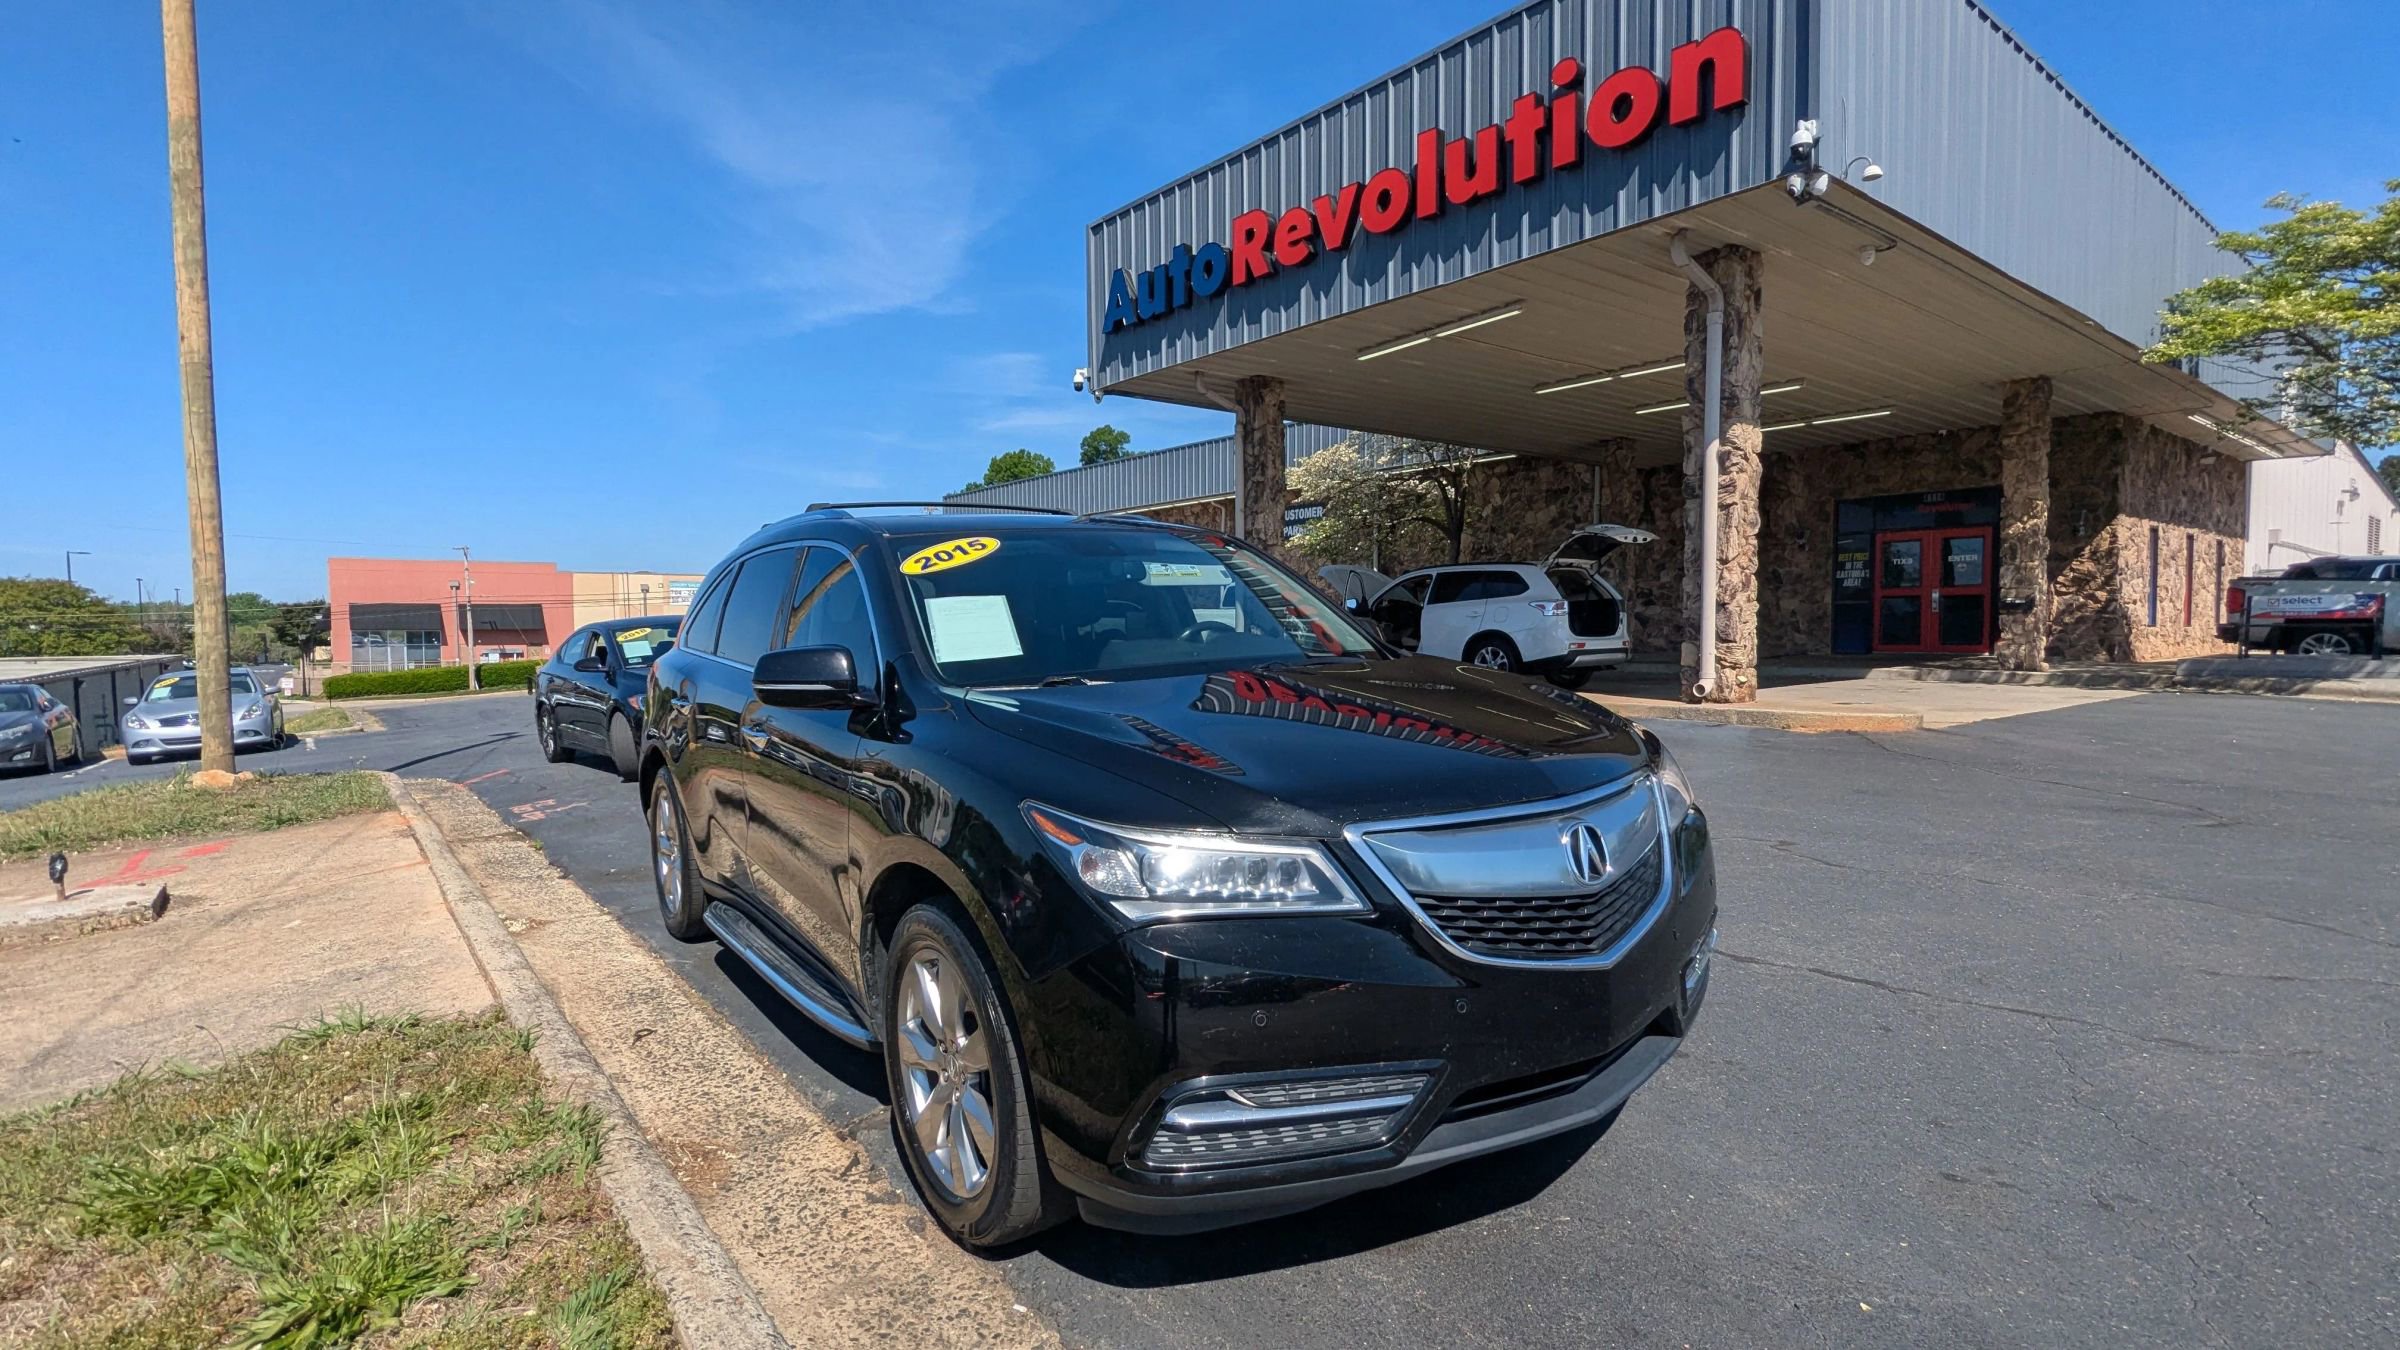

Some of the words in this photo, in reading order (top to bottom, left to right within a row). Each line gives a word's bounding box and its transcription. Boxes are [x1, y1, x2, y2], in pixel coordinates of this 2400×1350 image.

[1284, 506, 1323, 521] USTOMER
[914, 539, 987, 571] 2015
[1948, 554, 1977, 562] ENTER
[1853, 561, 1864, 569] THE
[2281, 595, 2323, 605] select
